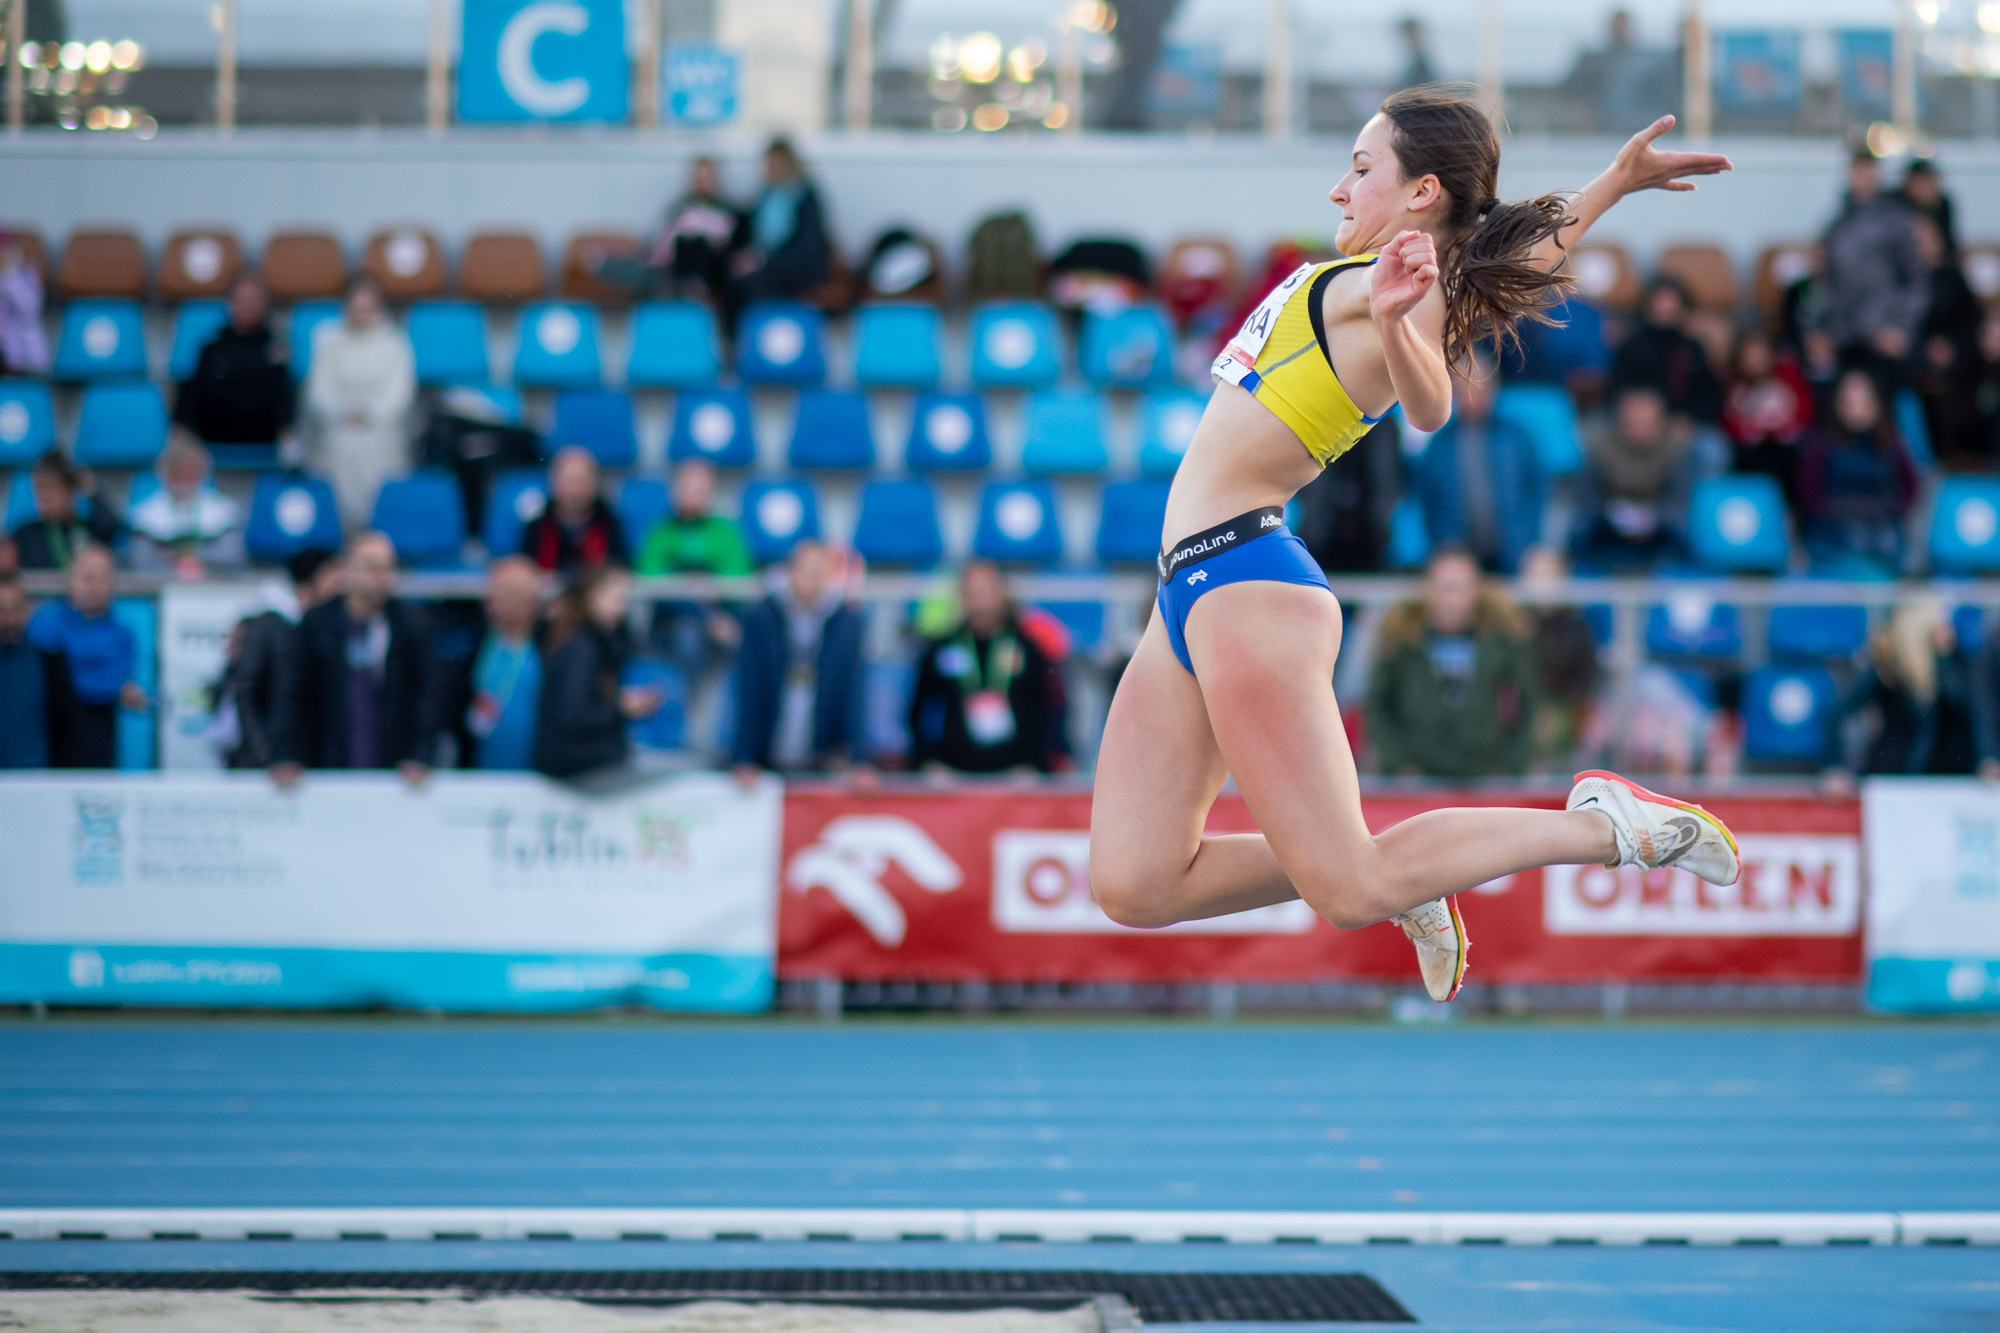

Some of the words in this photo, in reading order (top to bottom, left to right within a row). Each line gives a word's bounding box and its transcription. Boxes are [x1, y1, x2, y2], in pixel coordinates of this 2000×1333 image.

[498, 1, 589, 115] C
[1634, 827, 1657, 860] NIKE
[1574, 859, 1834, 910] ORLEN
